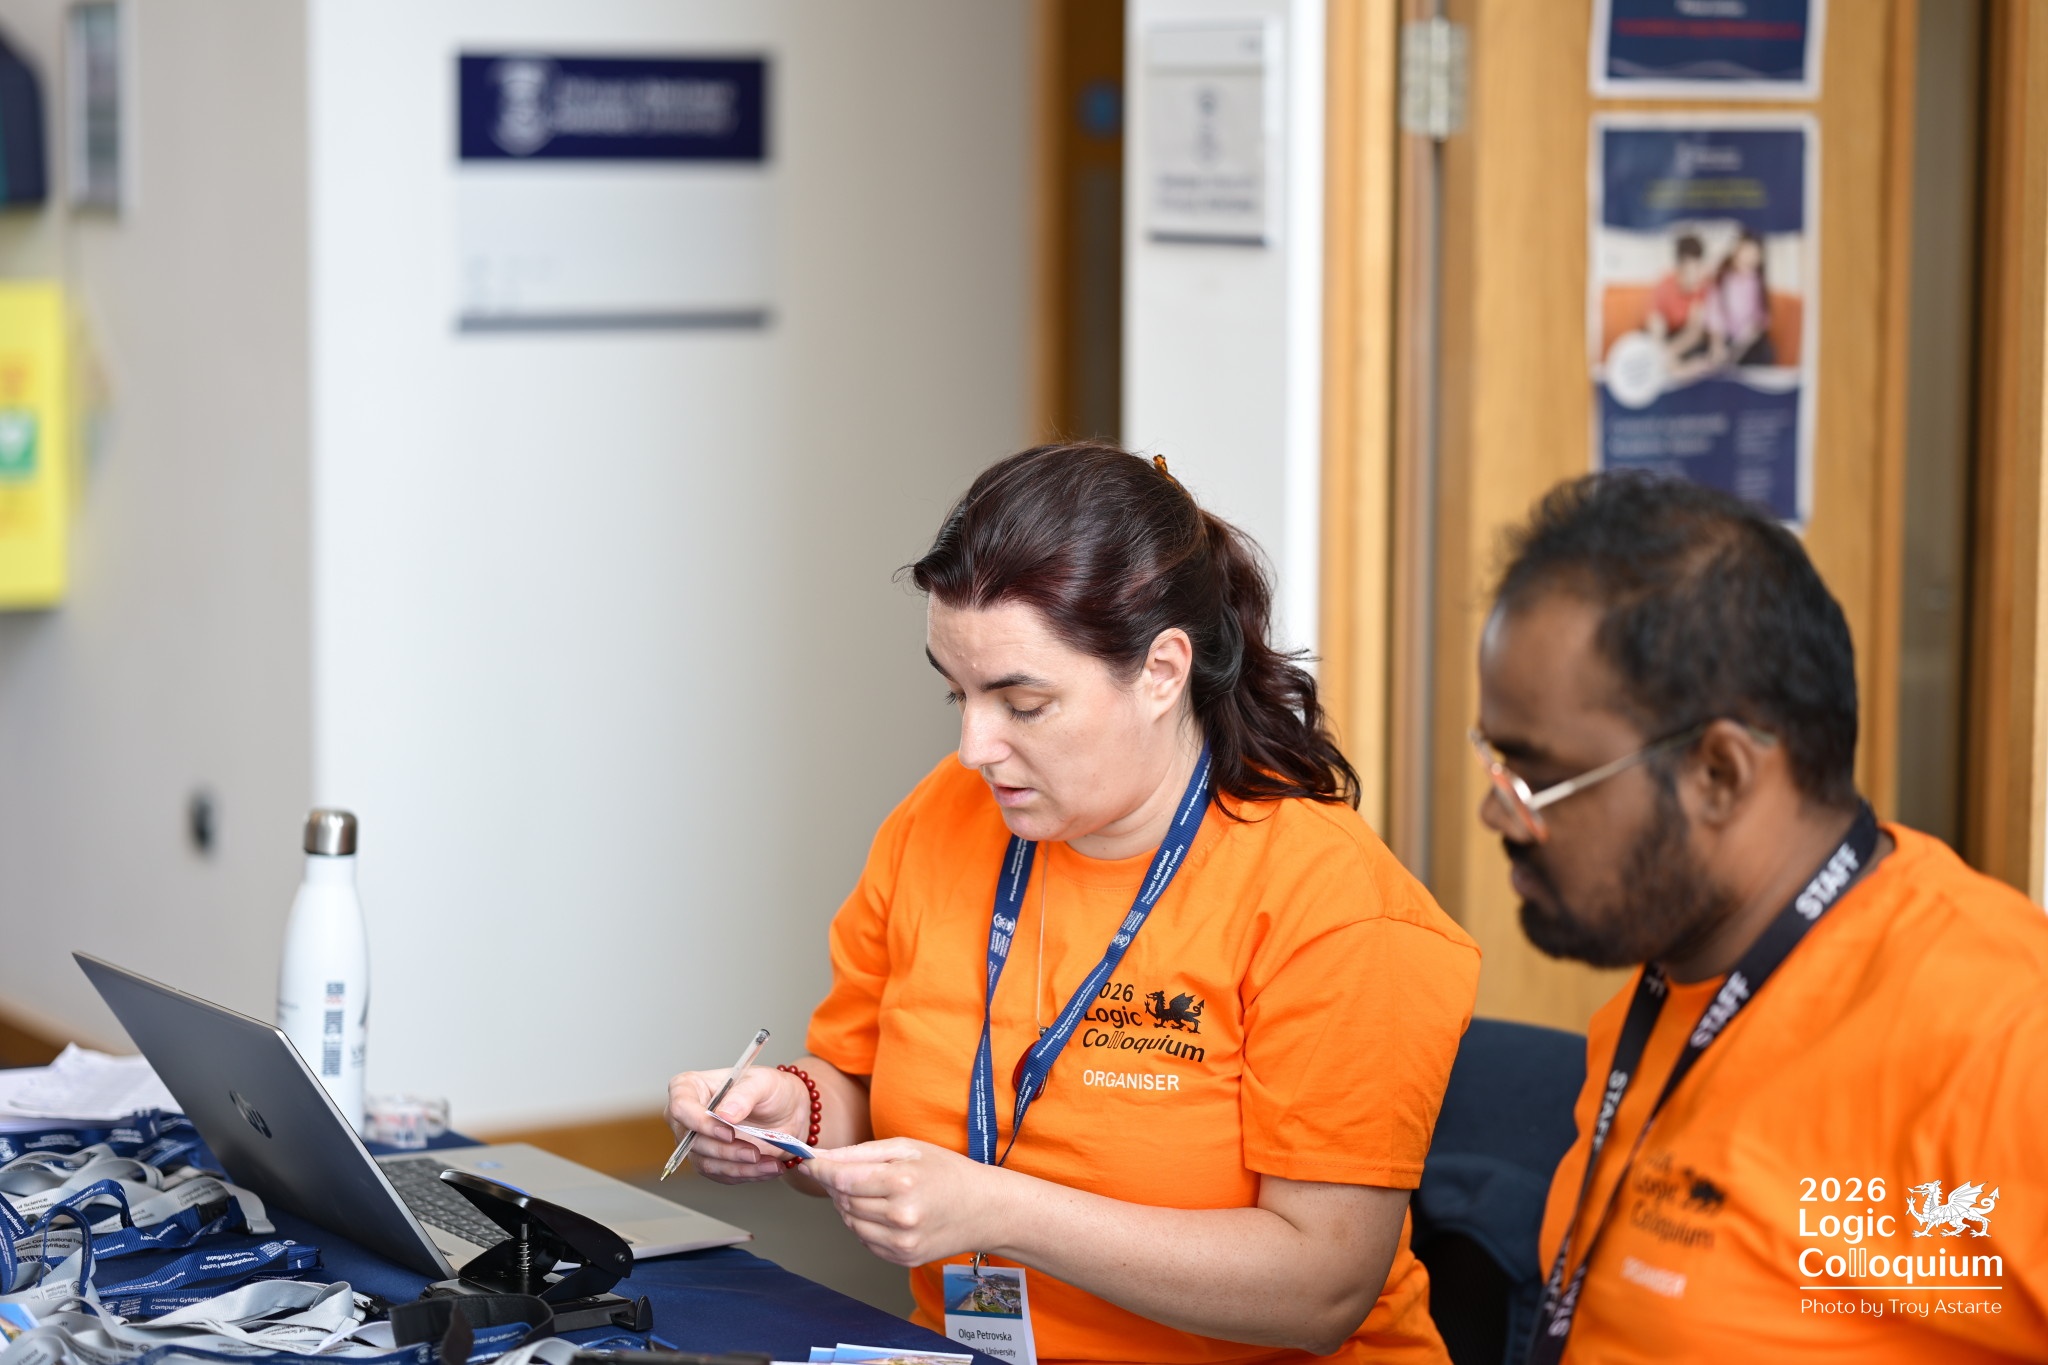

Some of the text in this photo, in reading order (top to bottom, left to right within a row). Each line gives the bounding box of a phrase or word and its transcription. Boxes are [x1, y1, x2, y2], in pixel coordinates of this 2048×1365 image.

[1146, 844, 1184, 905] Computational Foundry
[1153, 850, 1170, 880] Gyfrifiadol
[1795, 842, 1859, 920] STAFF
[1099, 982, 1134, 1002] 026
[1083, 1005, 1143, 1029] Logic
[1690, 971, 1750, 1049] STAFF
[1082, 1028, 1205, 1063] Colloquium
[1083, 1069, 1180, 1091] ORGANISER
[1593, 1069, 1628, 1151] STAFF
[44, 1240, 70, 1250] yfrifiadol
[958, 1328, 1012, 1341] Olga Petrovska
[986, 1347, 1017, 1358] University
